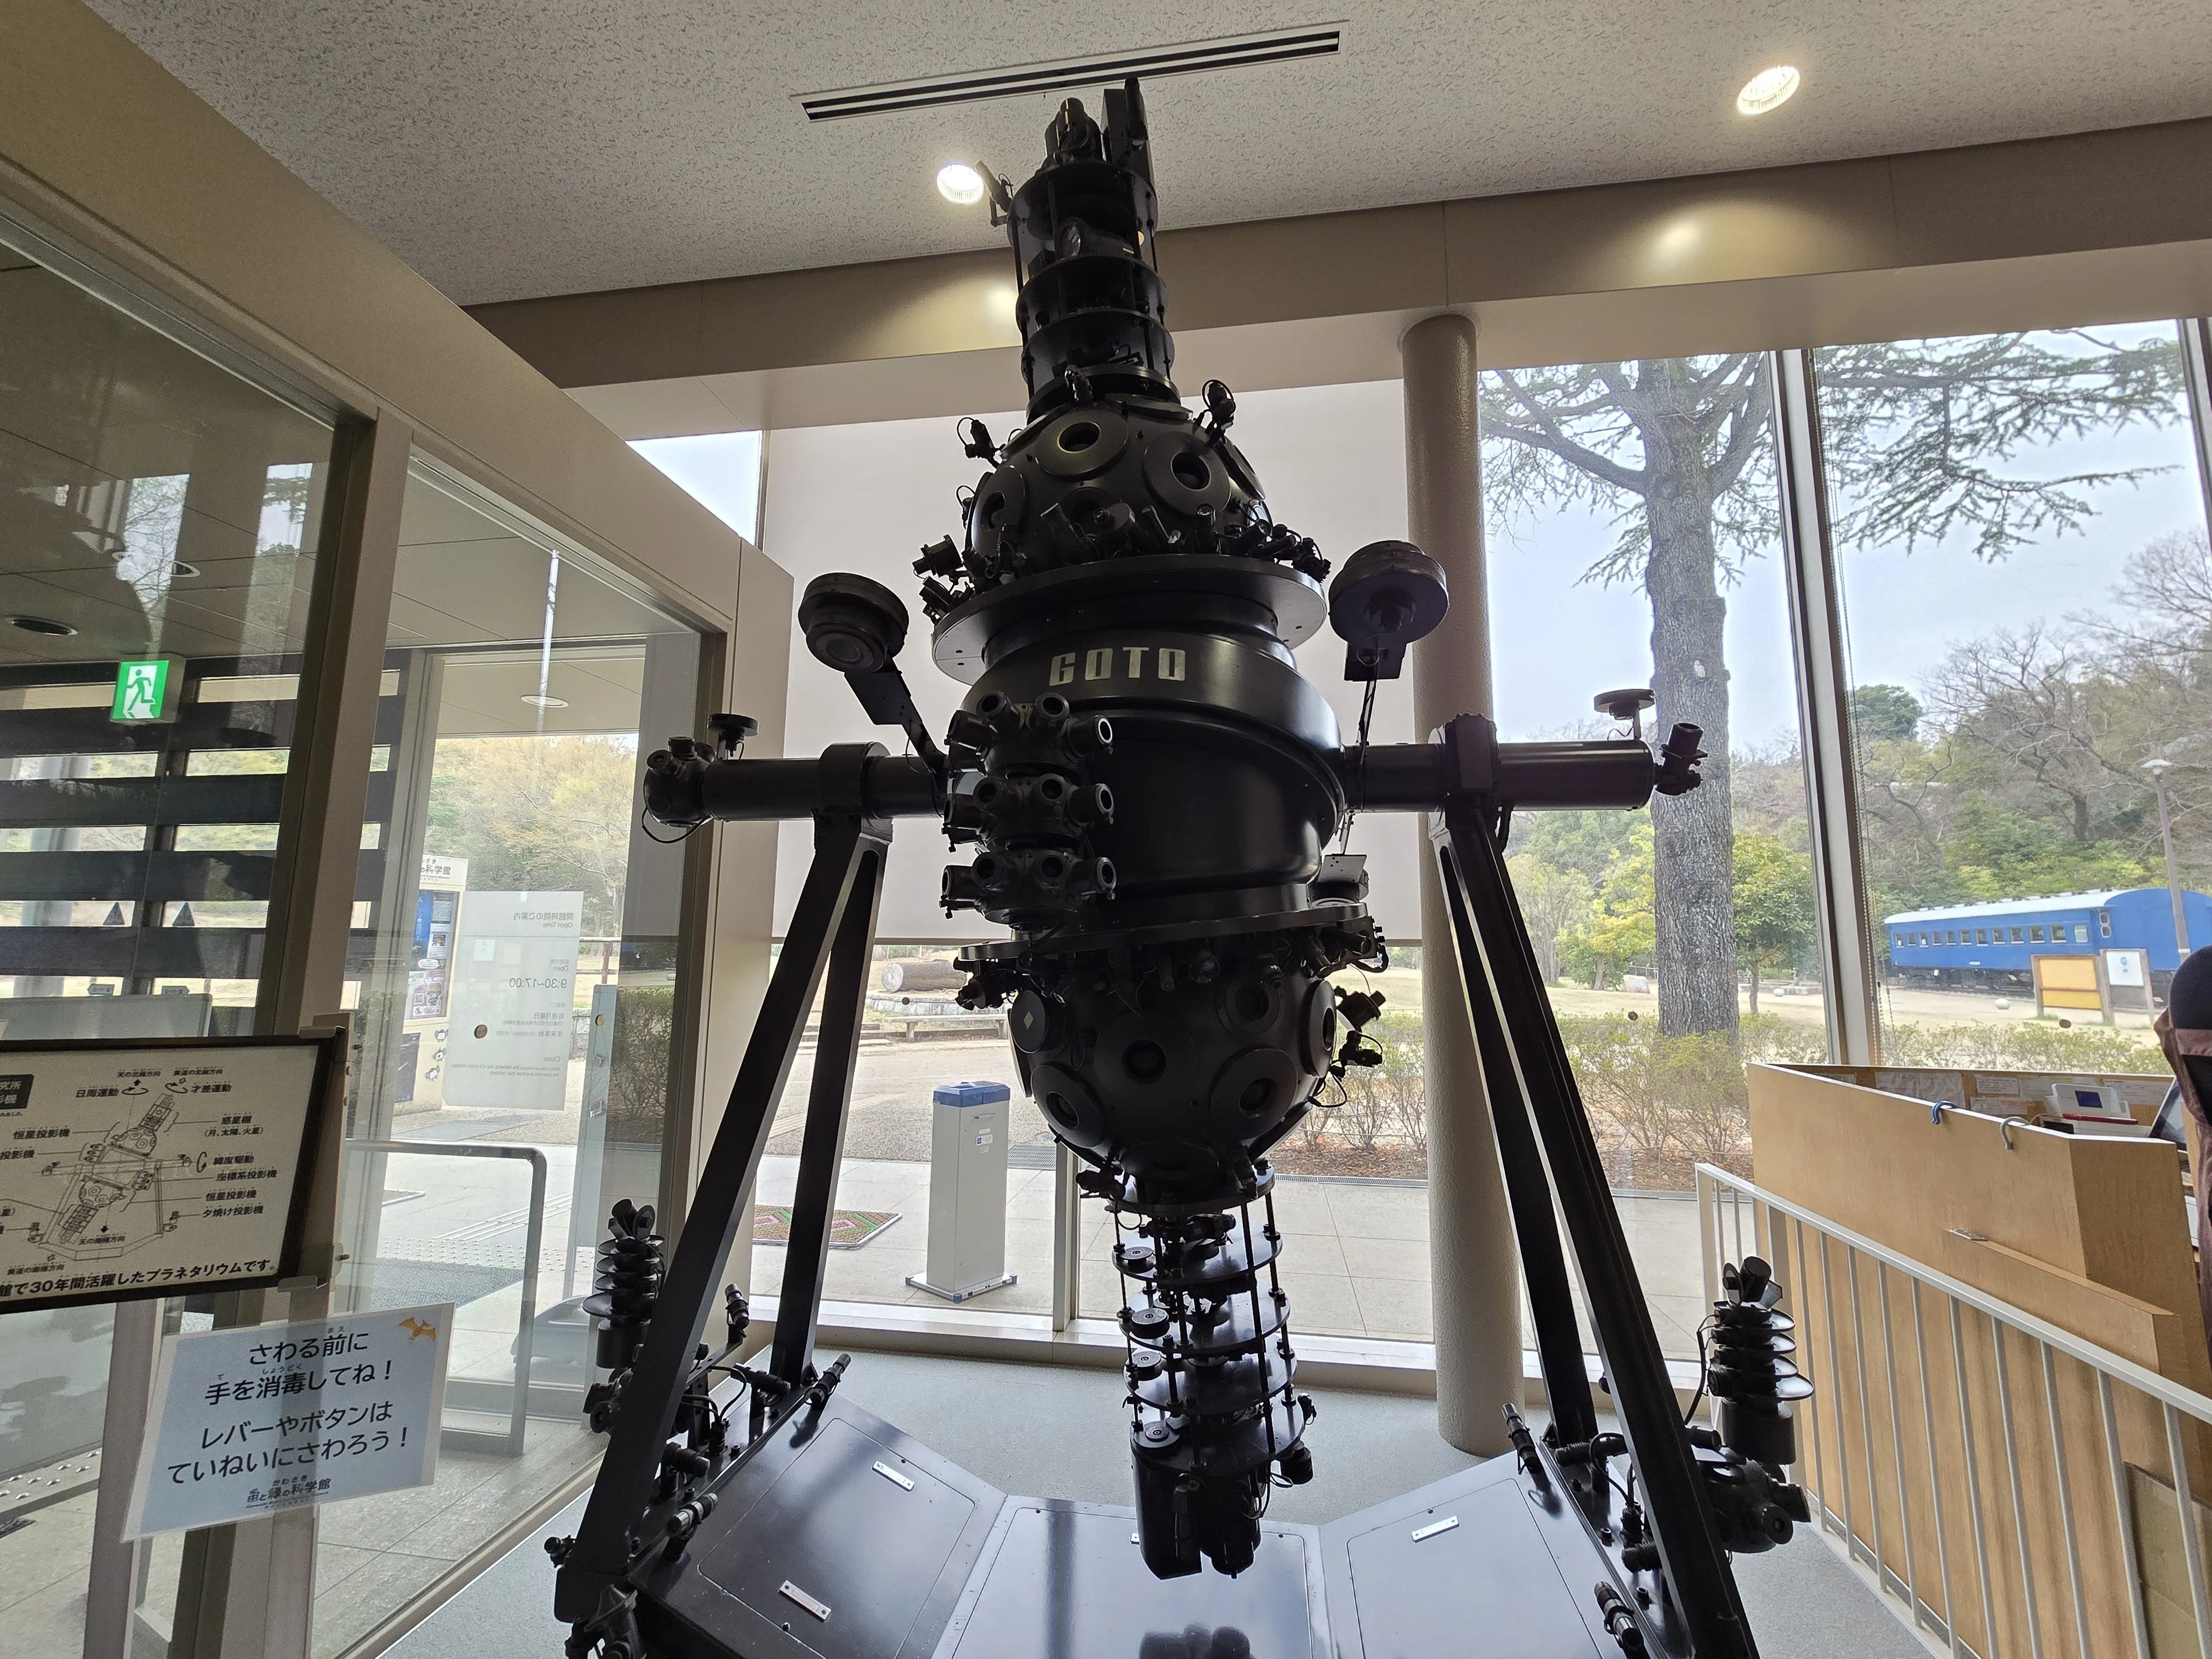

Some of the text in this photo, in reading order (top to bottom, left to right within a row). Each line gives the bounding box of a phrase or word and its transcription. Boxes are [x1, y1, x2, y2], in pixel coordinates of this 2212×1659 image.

[1049, 646, 1185, 686] GOTO
[76, 1088, 119, 1098] 日周運動
[191, 1084, 232, 1093] 才差運動
[13, 1128, 70, 1140] 恒星投影機
[213, 1155, 254, 1165] 緯度駆動
[216, 1170, 277, 1181] 座標系投影機
[206, 1190, 257, 1202] 恒星投影機
[202, 1206, 264, 1218] 夕焼け投影機
[250, 1333, 369, 1365] さわる前に
[263, 1364, 303, 1375] しょうどく
[205, 1360, 392, 1405] 手を消毒してね！
[201, 1401, 393, 1449] レバーやボタンは
[168, 1427, 408, 1484] ていねいにさわろう！
[272, 1475, 307, 1486] かわさき
